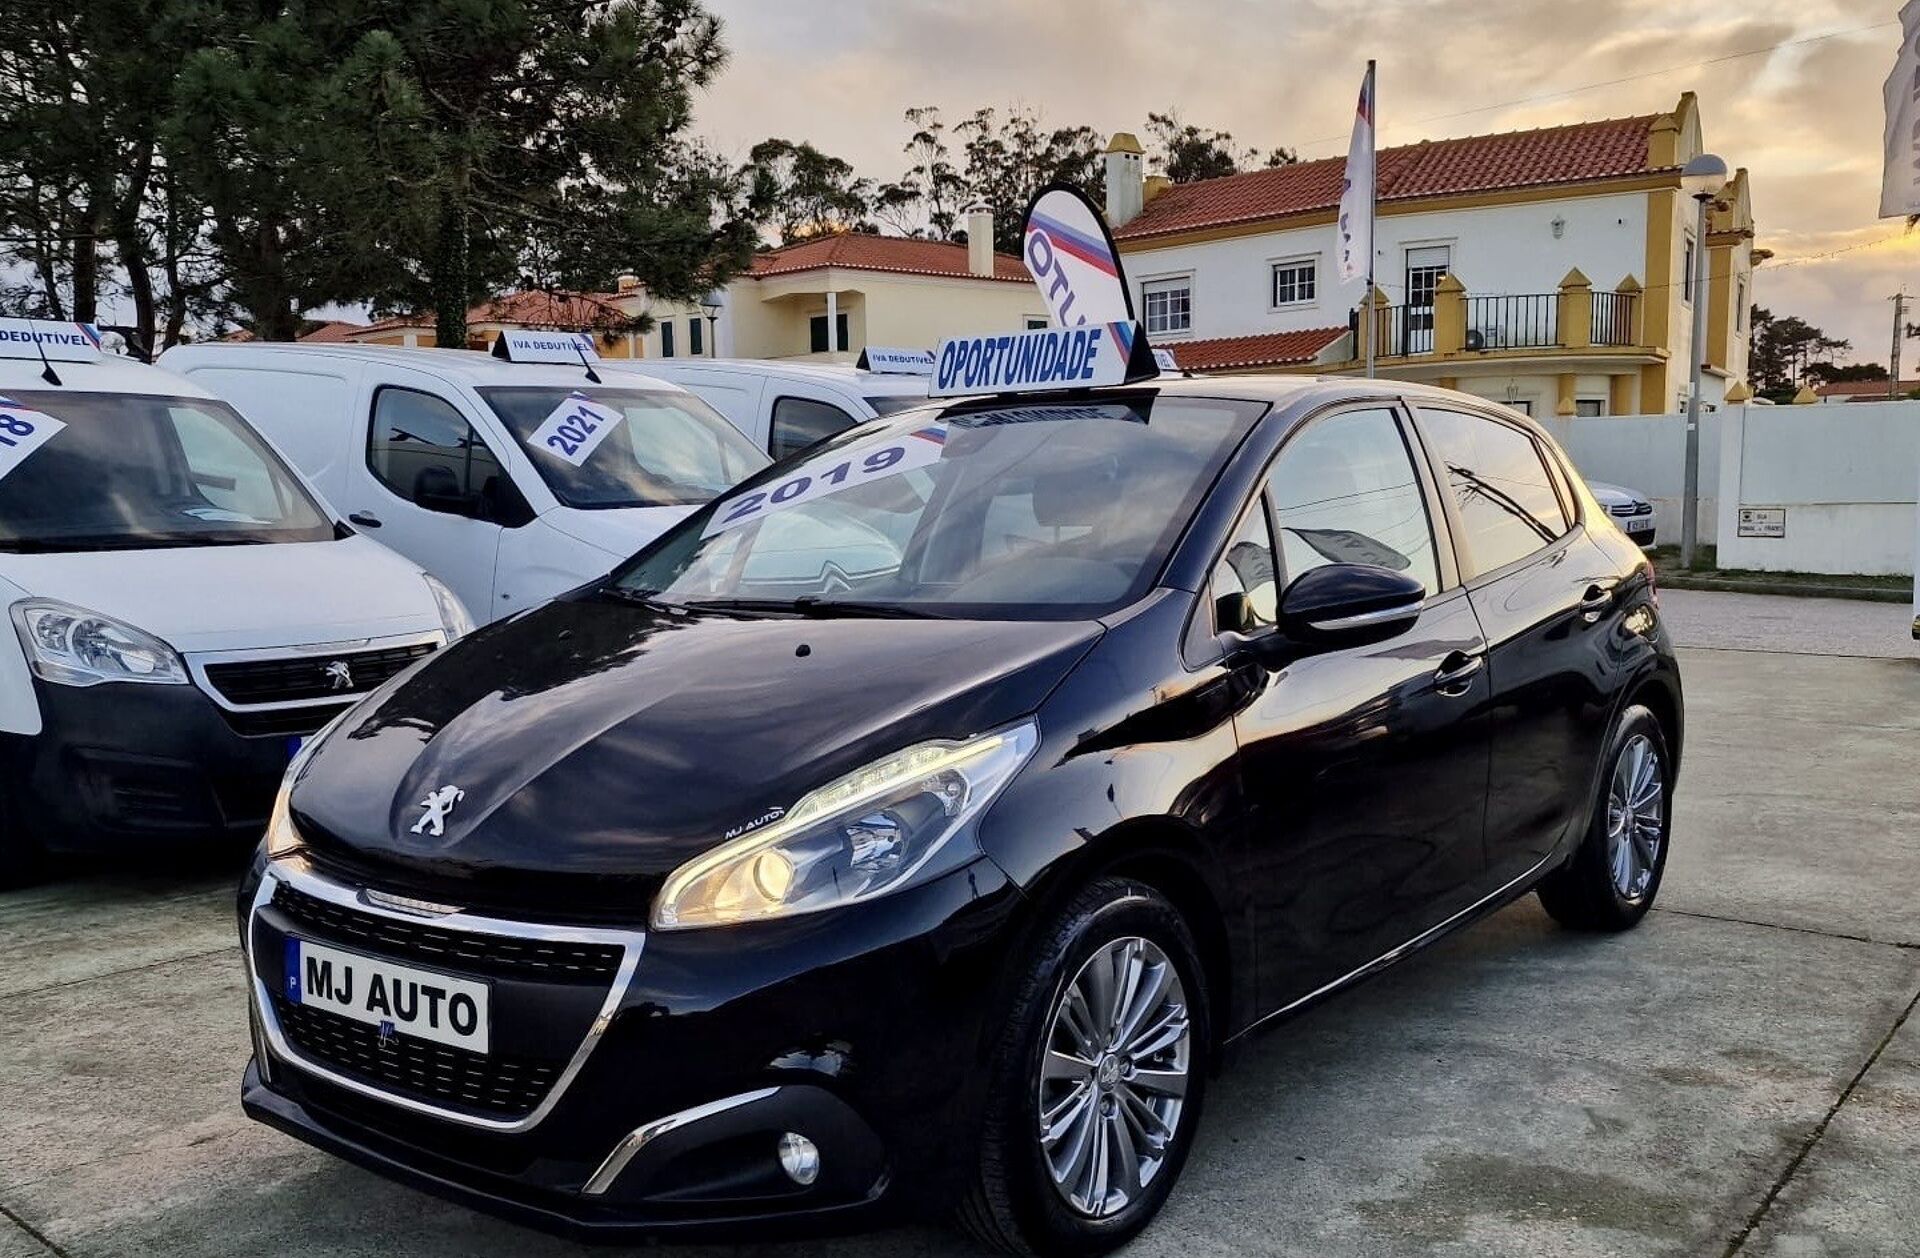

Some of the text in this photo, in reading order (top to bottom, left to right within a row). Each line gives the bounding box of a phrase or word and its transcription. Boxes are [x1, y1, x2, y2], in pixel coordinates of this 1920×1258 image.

[513, 340, 532, 349] IVA
[938, 328, 1102, 390] OPORTUNIDADE
[547, 405, 605, 456] 2021
[722, 447, 906, 524] 2019
[725, 826, 742, 839] MJ
[290, 976, 297, 989] P
[306, 956, 478, 1037] MJ AUTO
